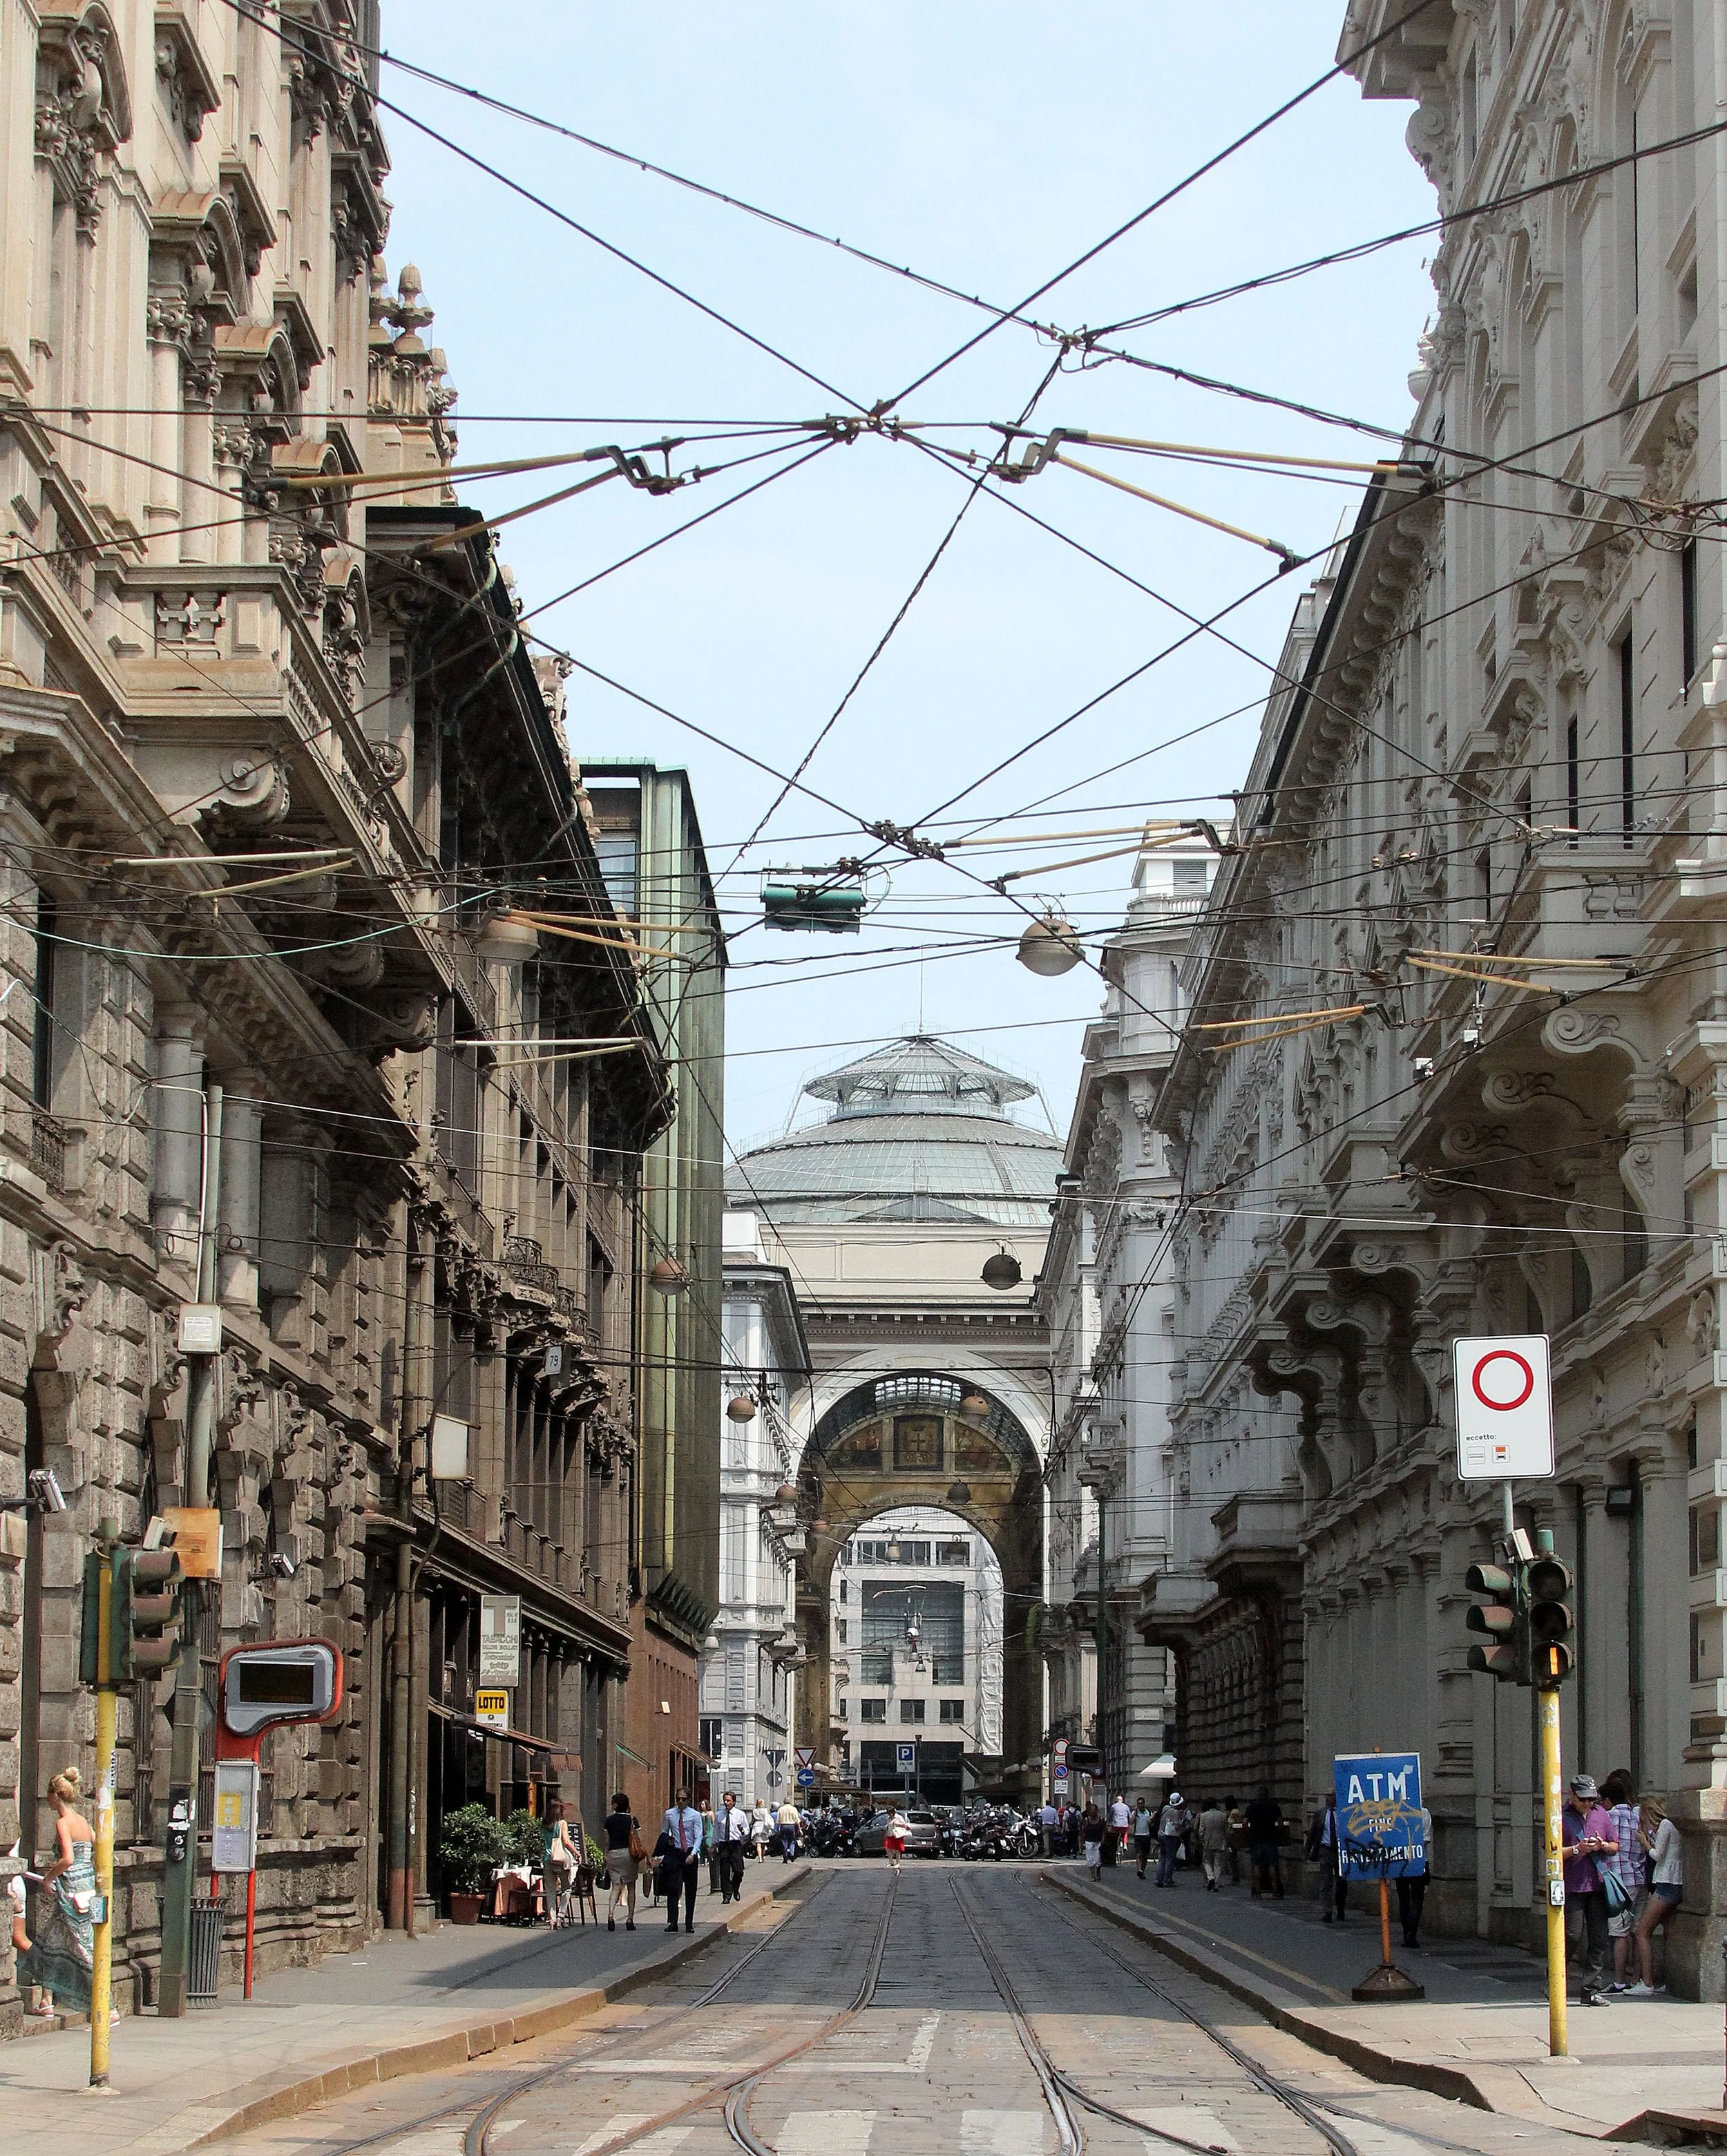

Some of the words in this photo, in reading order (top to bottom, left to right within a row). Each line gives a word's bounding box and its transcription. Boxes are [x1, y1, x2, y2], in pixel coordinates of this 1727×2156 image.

[549, 1355, 559, 1367] 79
[484, 1596, 517, 1636] T
[481, 1634, 518, 1643] TABACCHI
[478, 1697, 504, 1709] LOTTO
[901, 1748, 910, 1759] P
